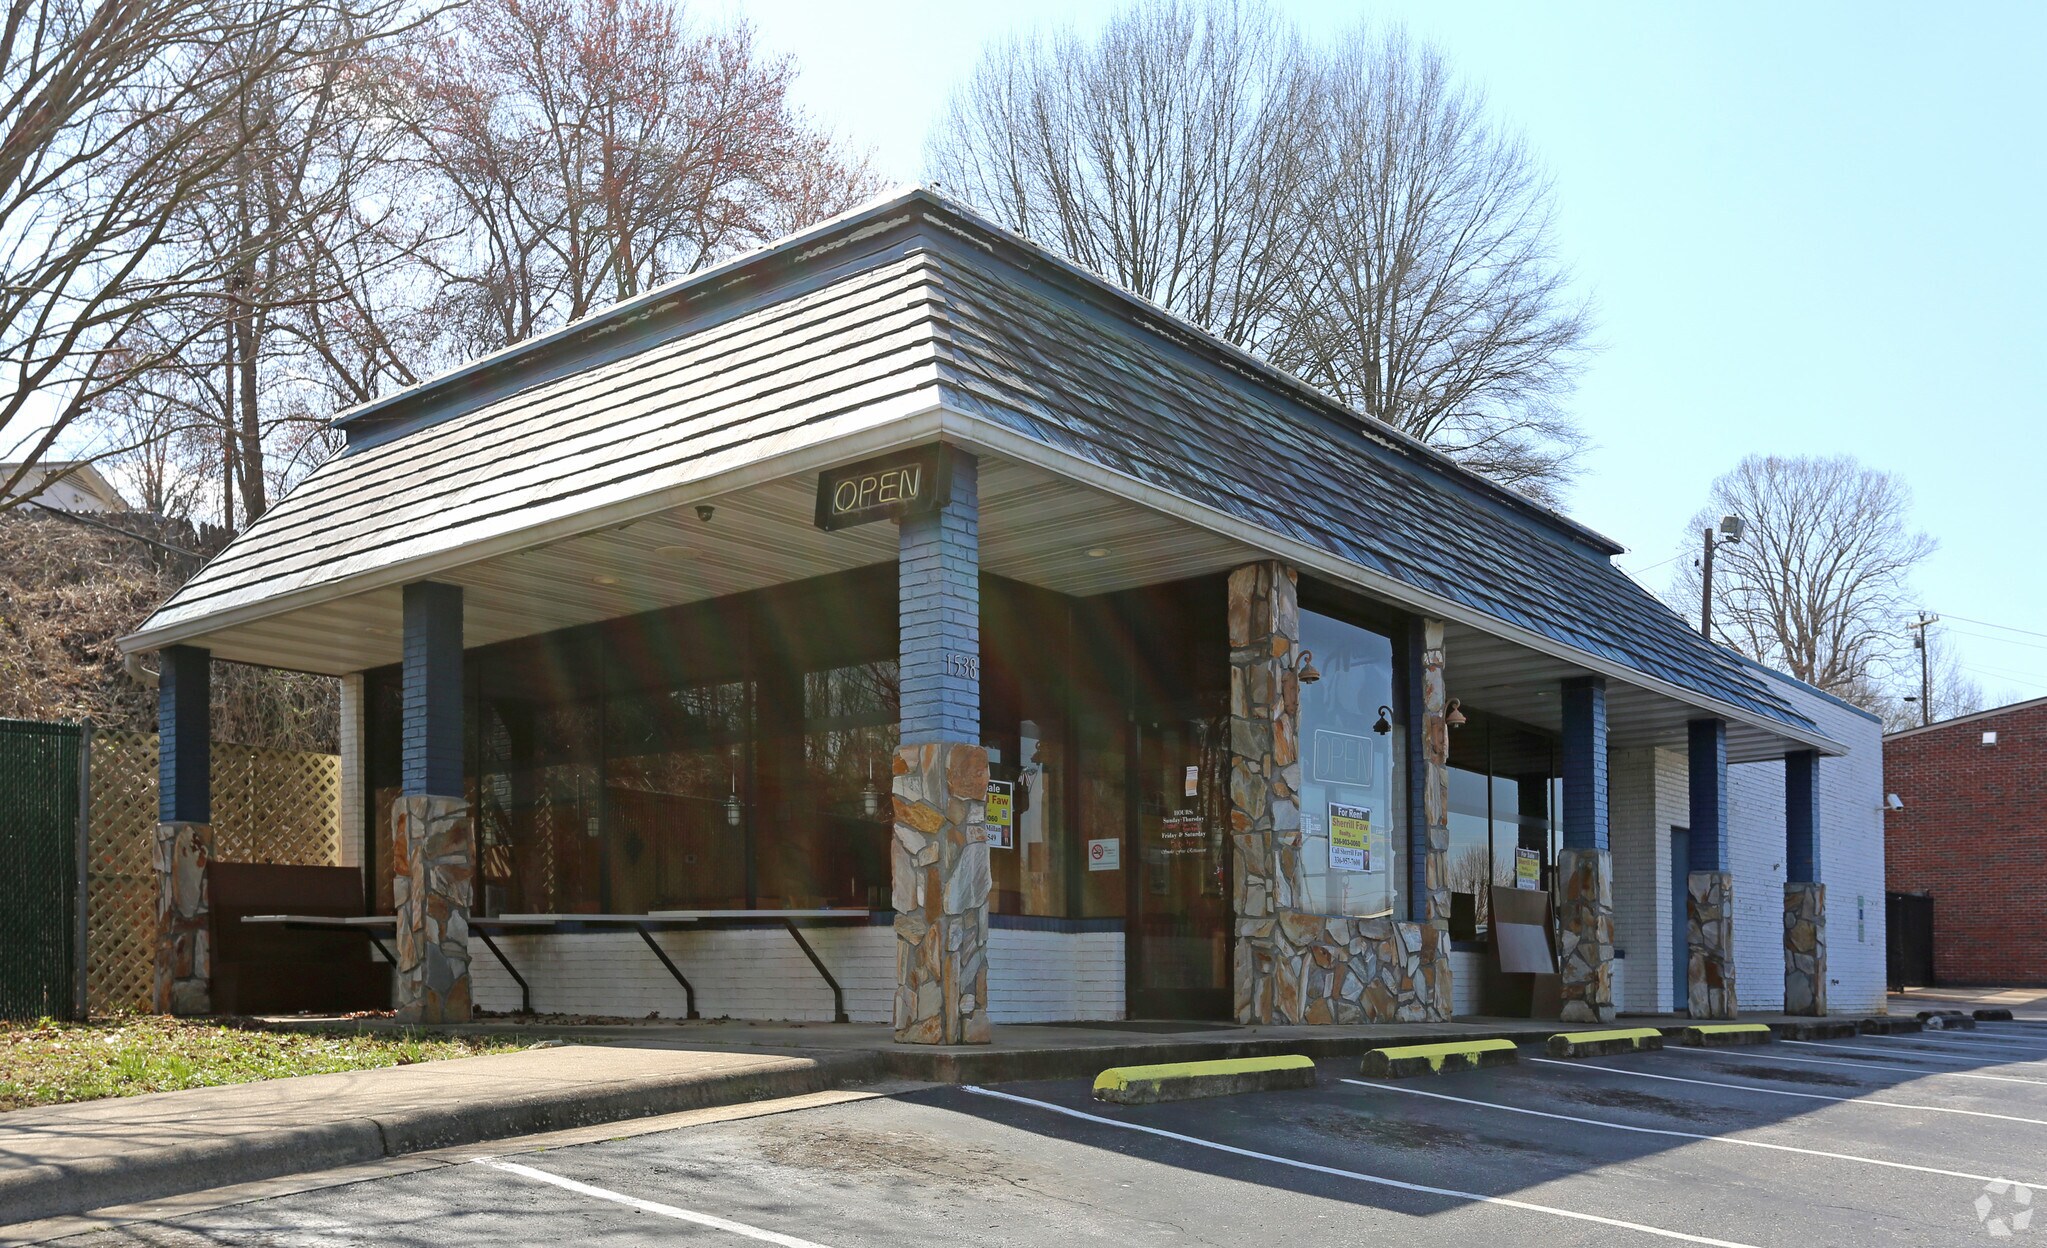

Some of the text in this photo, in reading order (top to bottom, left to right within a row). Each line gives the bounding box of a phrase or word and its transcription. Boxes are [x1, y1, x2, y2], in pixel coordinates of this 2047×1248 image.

[835, 468, 919, 511] OPEN
[946, 653, 976, 679] 1538
[1317, 735, 1370, 781] OPEN
[992, 795, 1009, 806] Faw
[1338, 807, 1363, 819] For Rent
[1332, 817, 1354, 829] Sherrill
[1355, 821, 1369, 831] Faw
